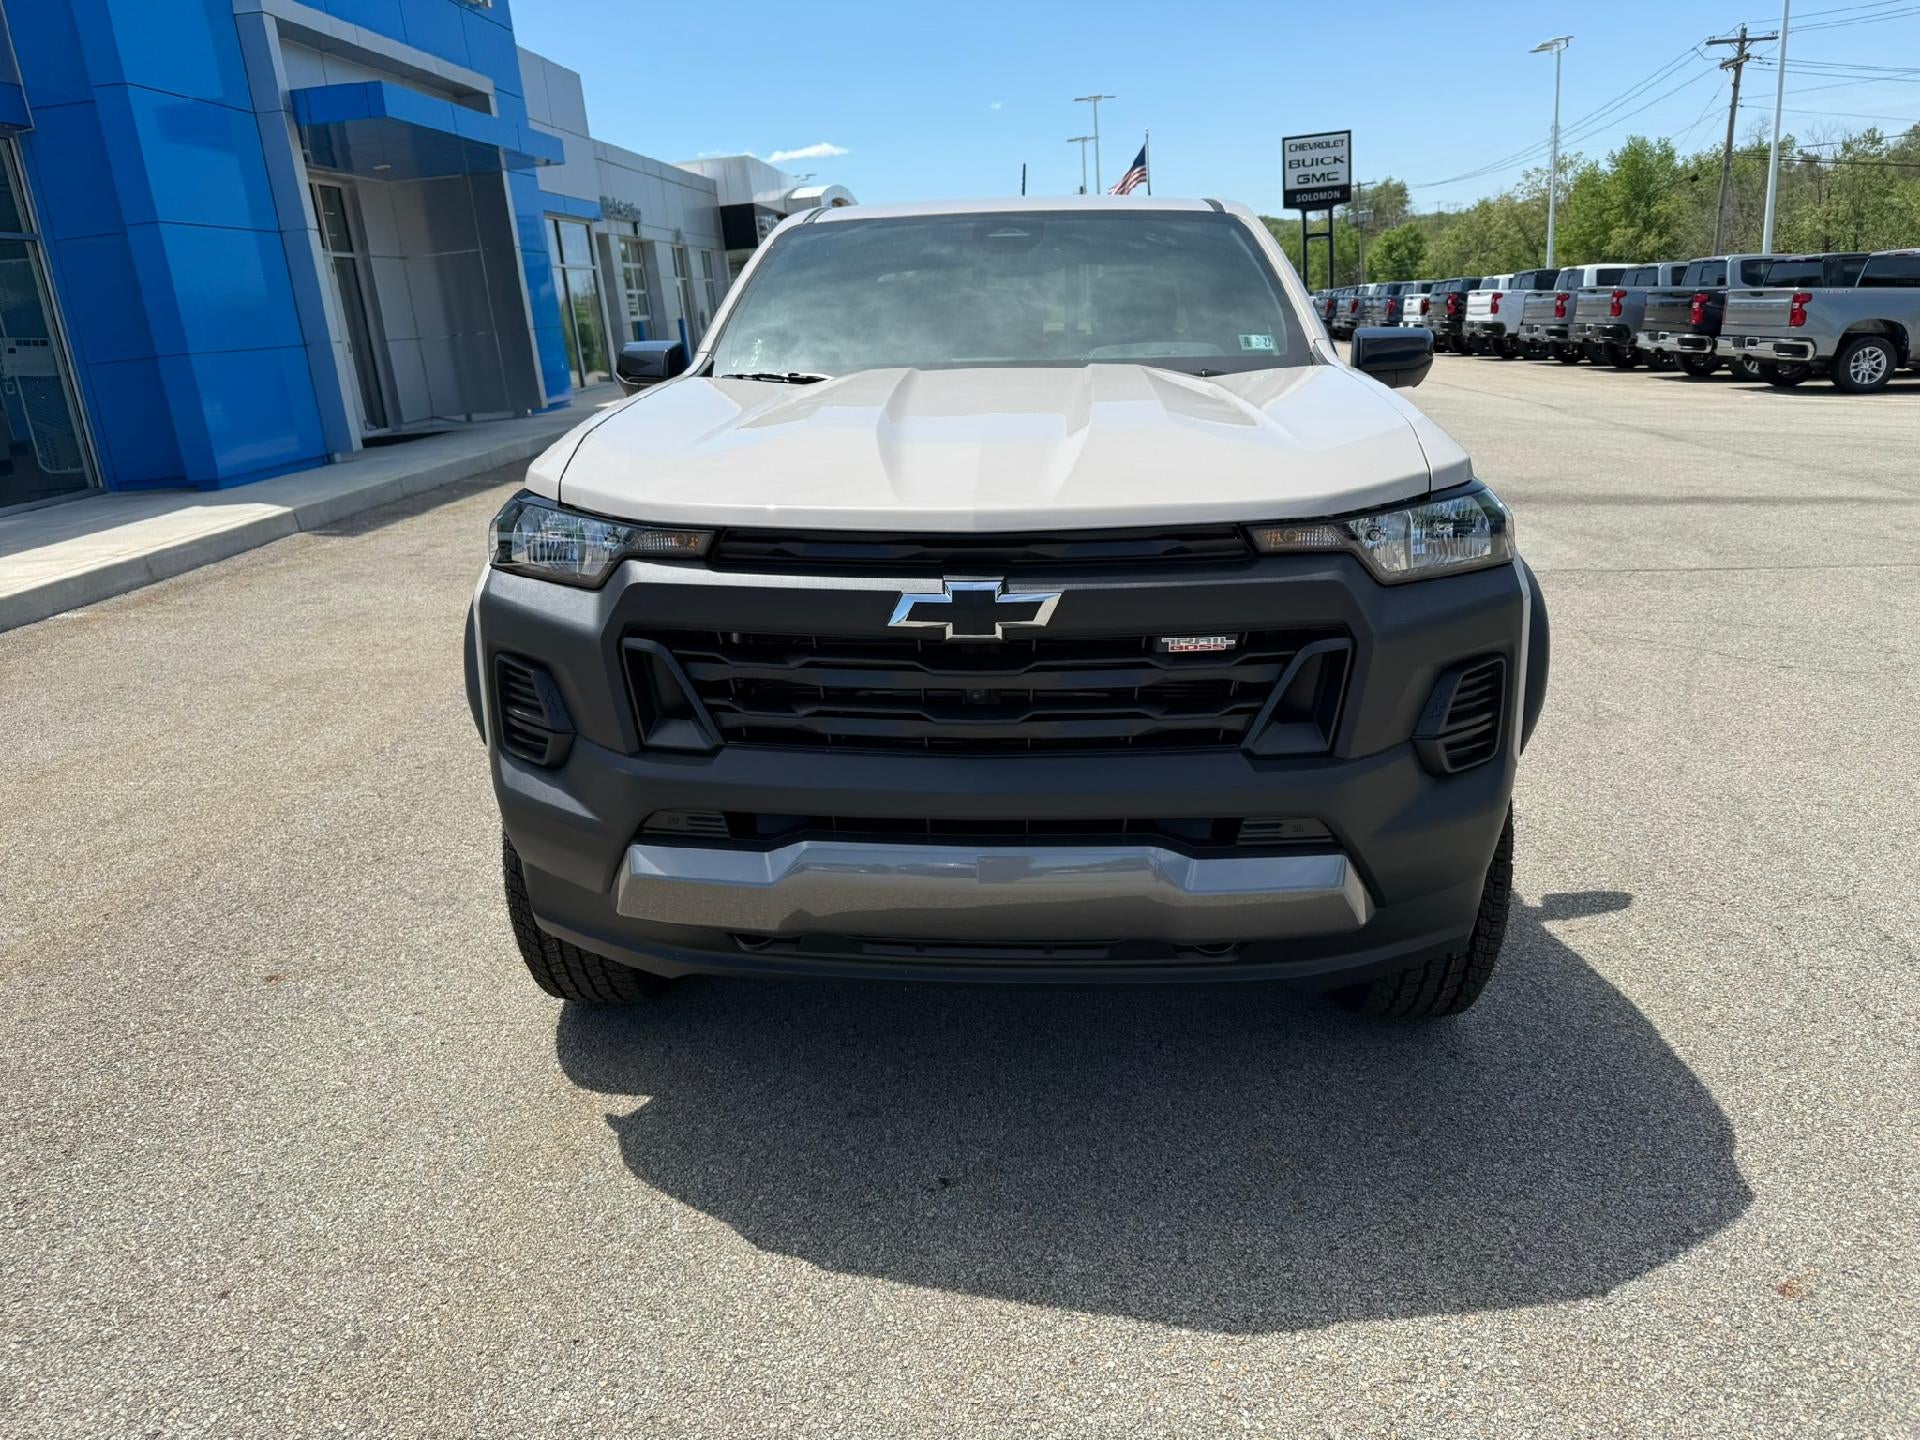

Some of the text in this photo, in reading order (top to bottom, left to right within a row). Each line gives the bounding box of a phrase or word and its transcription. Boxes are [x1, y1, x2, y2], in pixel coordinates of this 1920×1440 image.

[1288, 139, 1345, 152] CHEVROLET
[1288, 155, 1345, 169] BUICK
[1297, 171, 1340, 184] GMC
[1295, 190, 1341, 203] SOLOMON
[1161, 636, 1236, 646] TRAIL
[1169, 643, 1227, 652] BOSS
